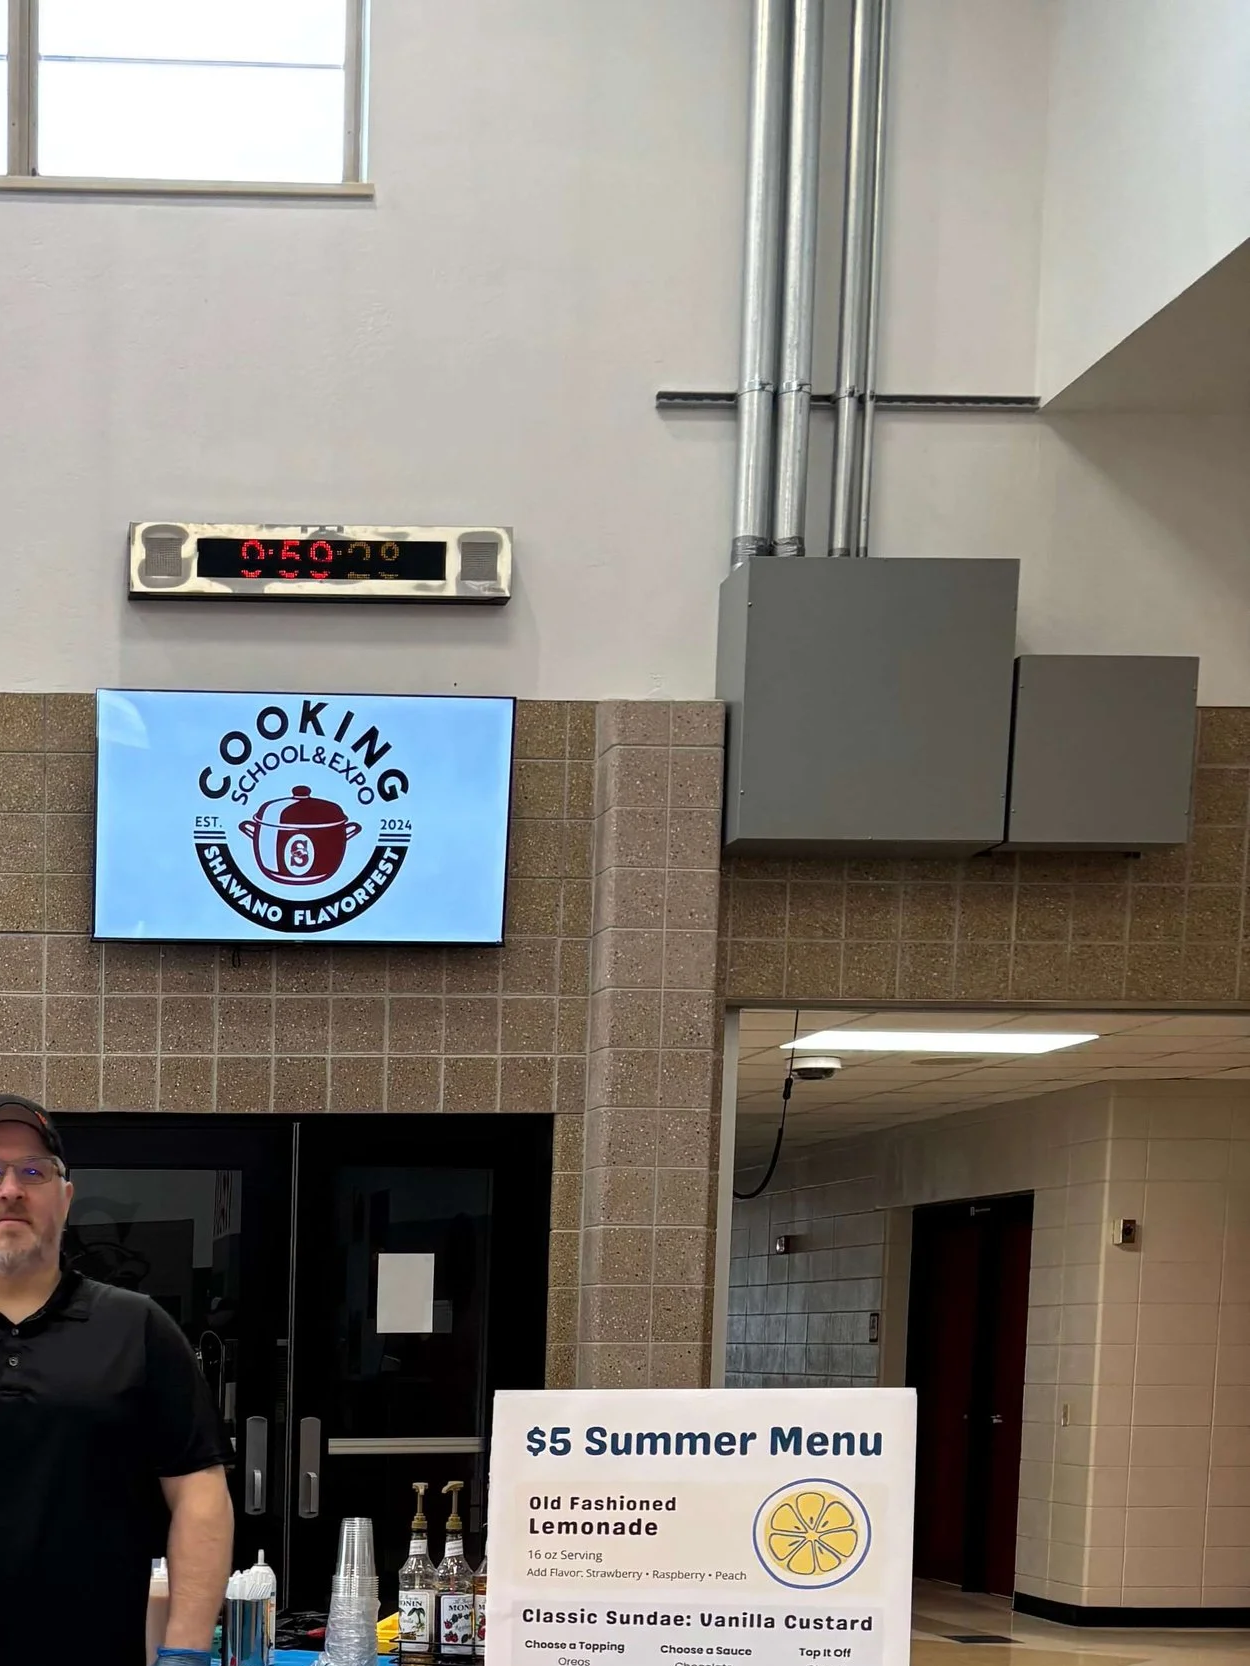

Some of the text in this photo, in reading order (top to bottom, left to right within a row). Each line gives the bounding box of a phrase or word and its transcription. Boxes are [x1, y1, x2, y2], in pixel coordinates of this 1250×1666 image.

[198, 700, 409, 802] COOKING
[196, 816, 222, 827] EST.
[381, 819, 411, 830] 2024
[203, 846, 400, 925] SHAWANO FLAVORFEST
[527, 1427, 882, 1456] $5 Summer Menu
[530, 1496, 676, 1511] Old Fashioned
[530, 1518, 657, 1535] Lemonade
[529, 1550, 541, 1559] 16
[561, 1550, 602, 1563] Serving
[527, 1568, 746, 1582] Add Flavor: Strawberry Raspberry Peach
[523, 1608, 872, 1631] Classic Sundae: Vanilla Custard
[525, 1640, 566, 1649] Choose
[579, 1642, 624, 1653] Topping
[661, 1645, 703, 1654] Choose
[716, 1647, 752, 1655] Sauce
[799, 1648, 851, 1659] Top It Off
[558, 1657, 590, 1666] Oreos
